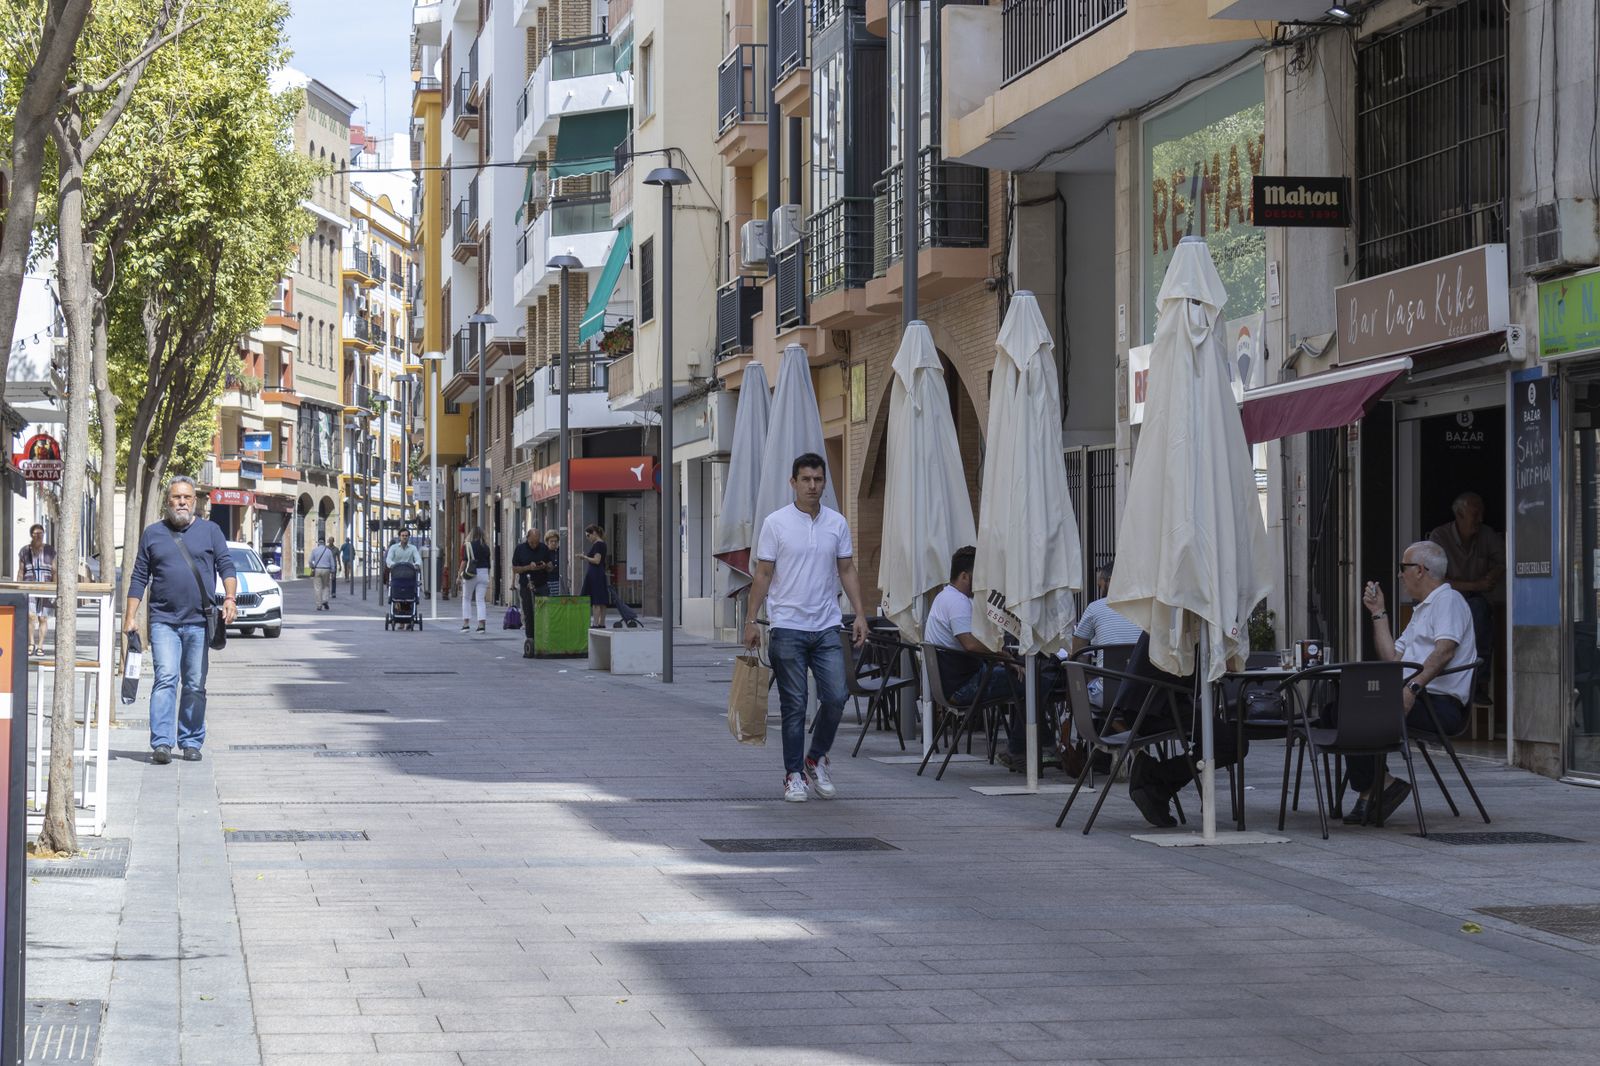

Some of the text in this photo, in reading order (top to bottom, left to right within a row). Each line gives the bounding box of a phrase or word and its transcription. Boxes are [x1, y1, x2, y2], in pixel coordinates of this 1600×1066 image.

[1264, 185, 1339, 205] Mahou
[1264, 209, 1304, 218] DESDE
[1348, 265, 1475, 344] Bar Casa Kike
[1523, 409, 1541, 422] BAZAR
[1446, 431, 1484, 441] BAZAR
[987, 610, 1010, 628] ESDE
